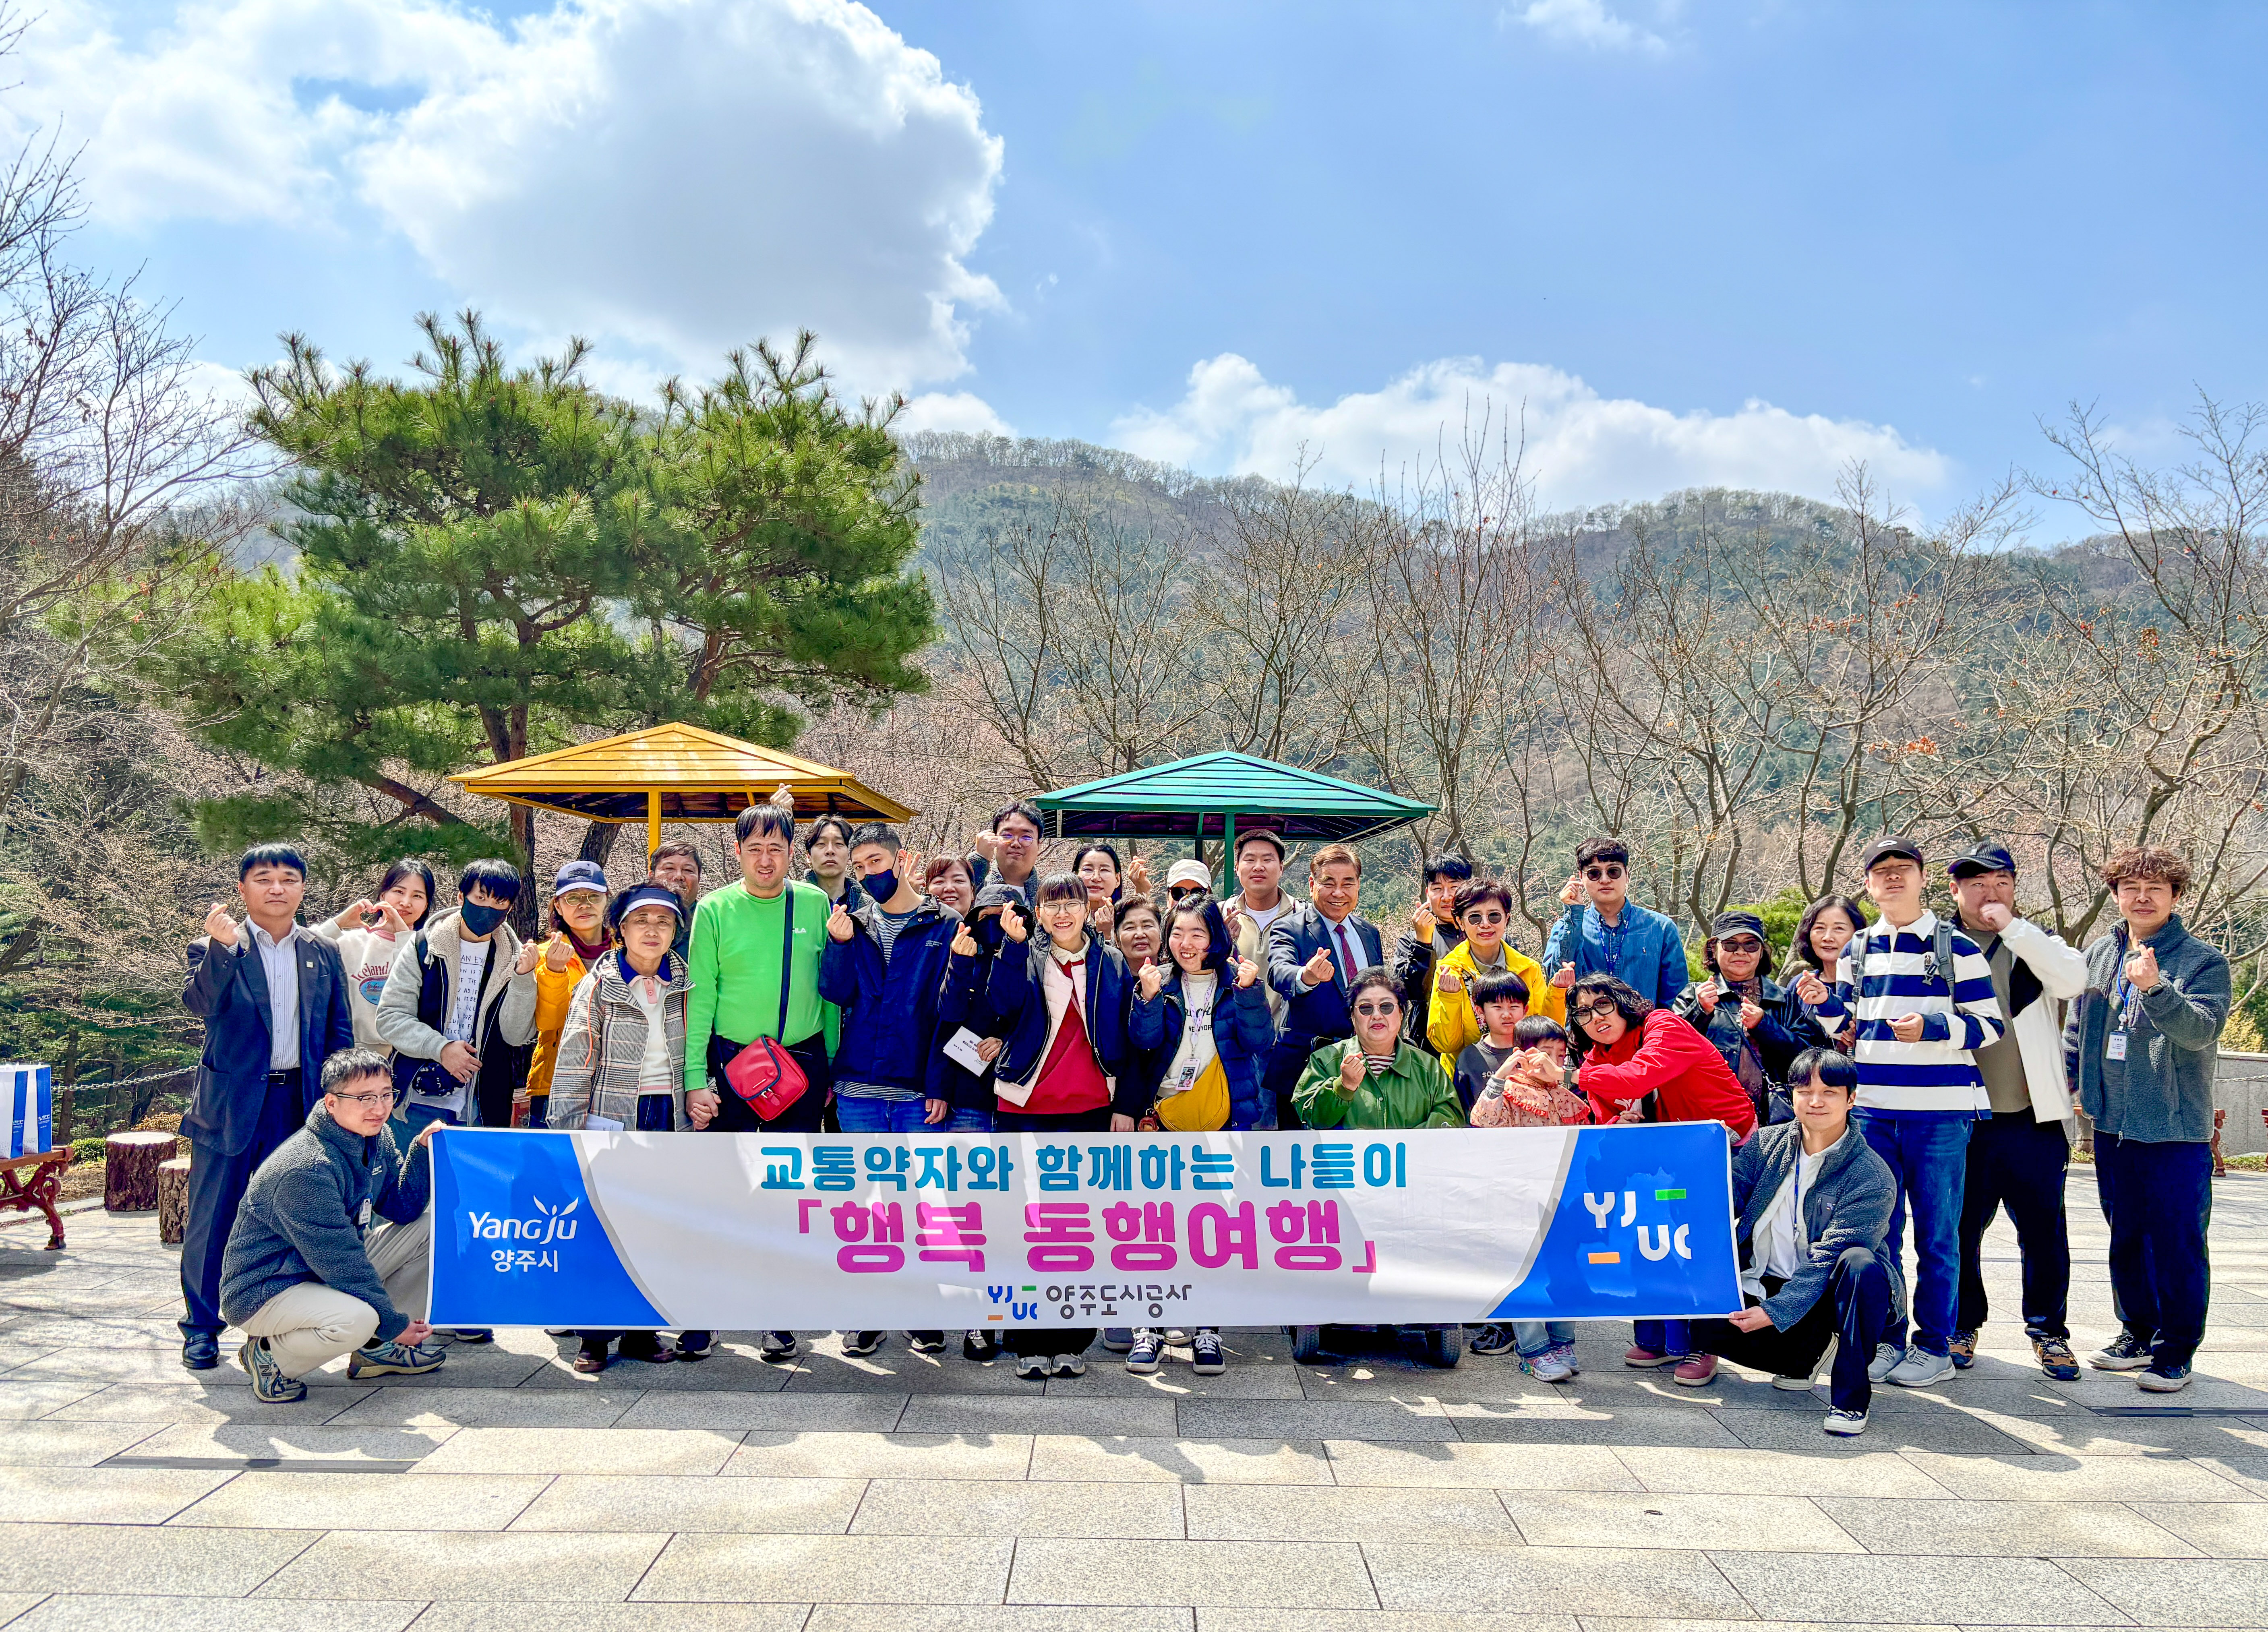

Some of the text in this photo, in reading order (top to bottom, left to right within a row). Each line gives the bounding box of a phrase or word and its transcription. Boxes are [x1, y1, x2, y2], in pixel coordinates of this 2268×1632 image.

[761, 1142, 1406, 1191] 교통약자와 함께하는 나들이
[491, 1249, 558, 1272] 양주시
[1046, 1285, 1192, 1319] 양주도시공사
